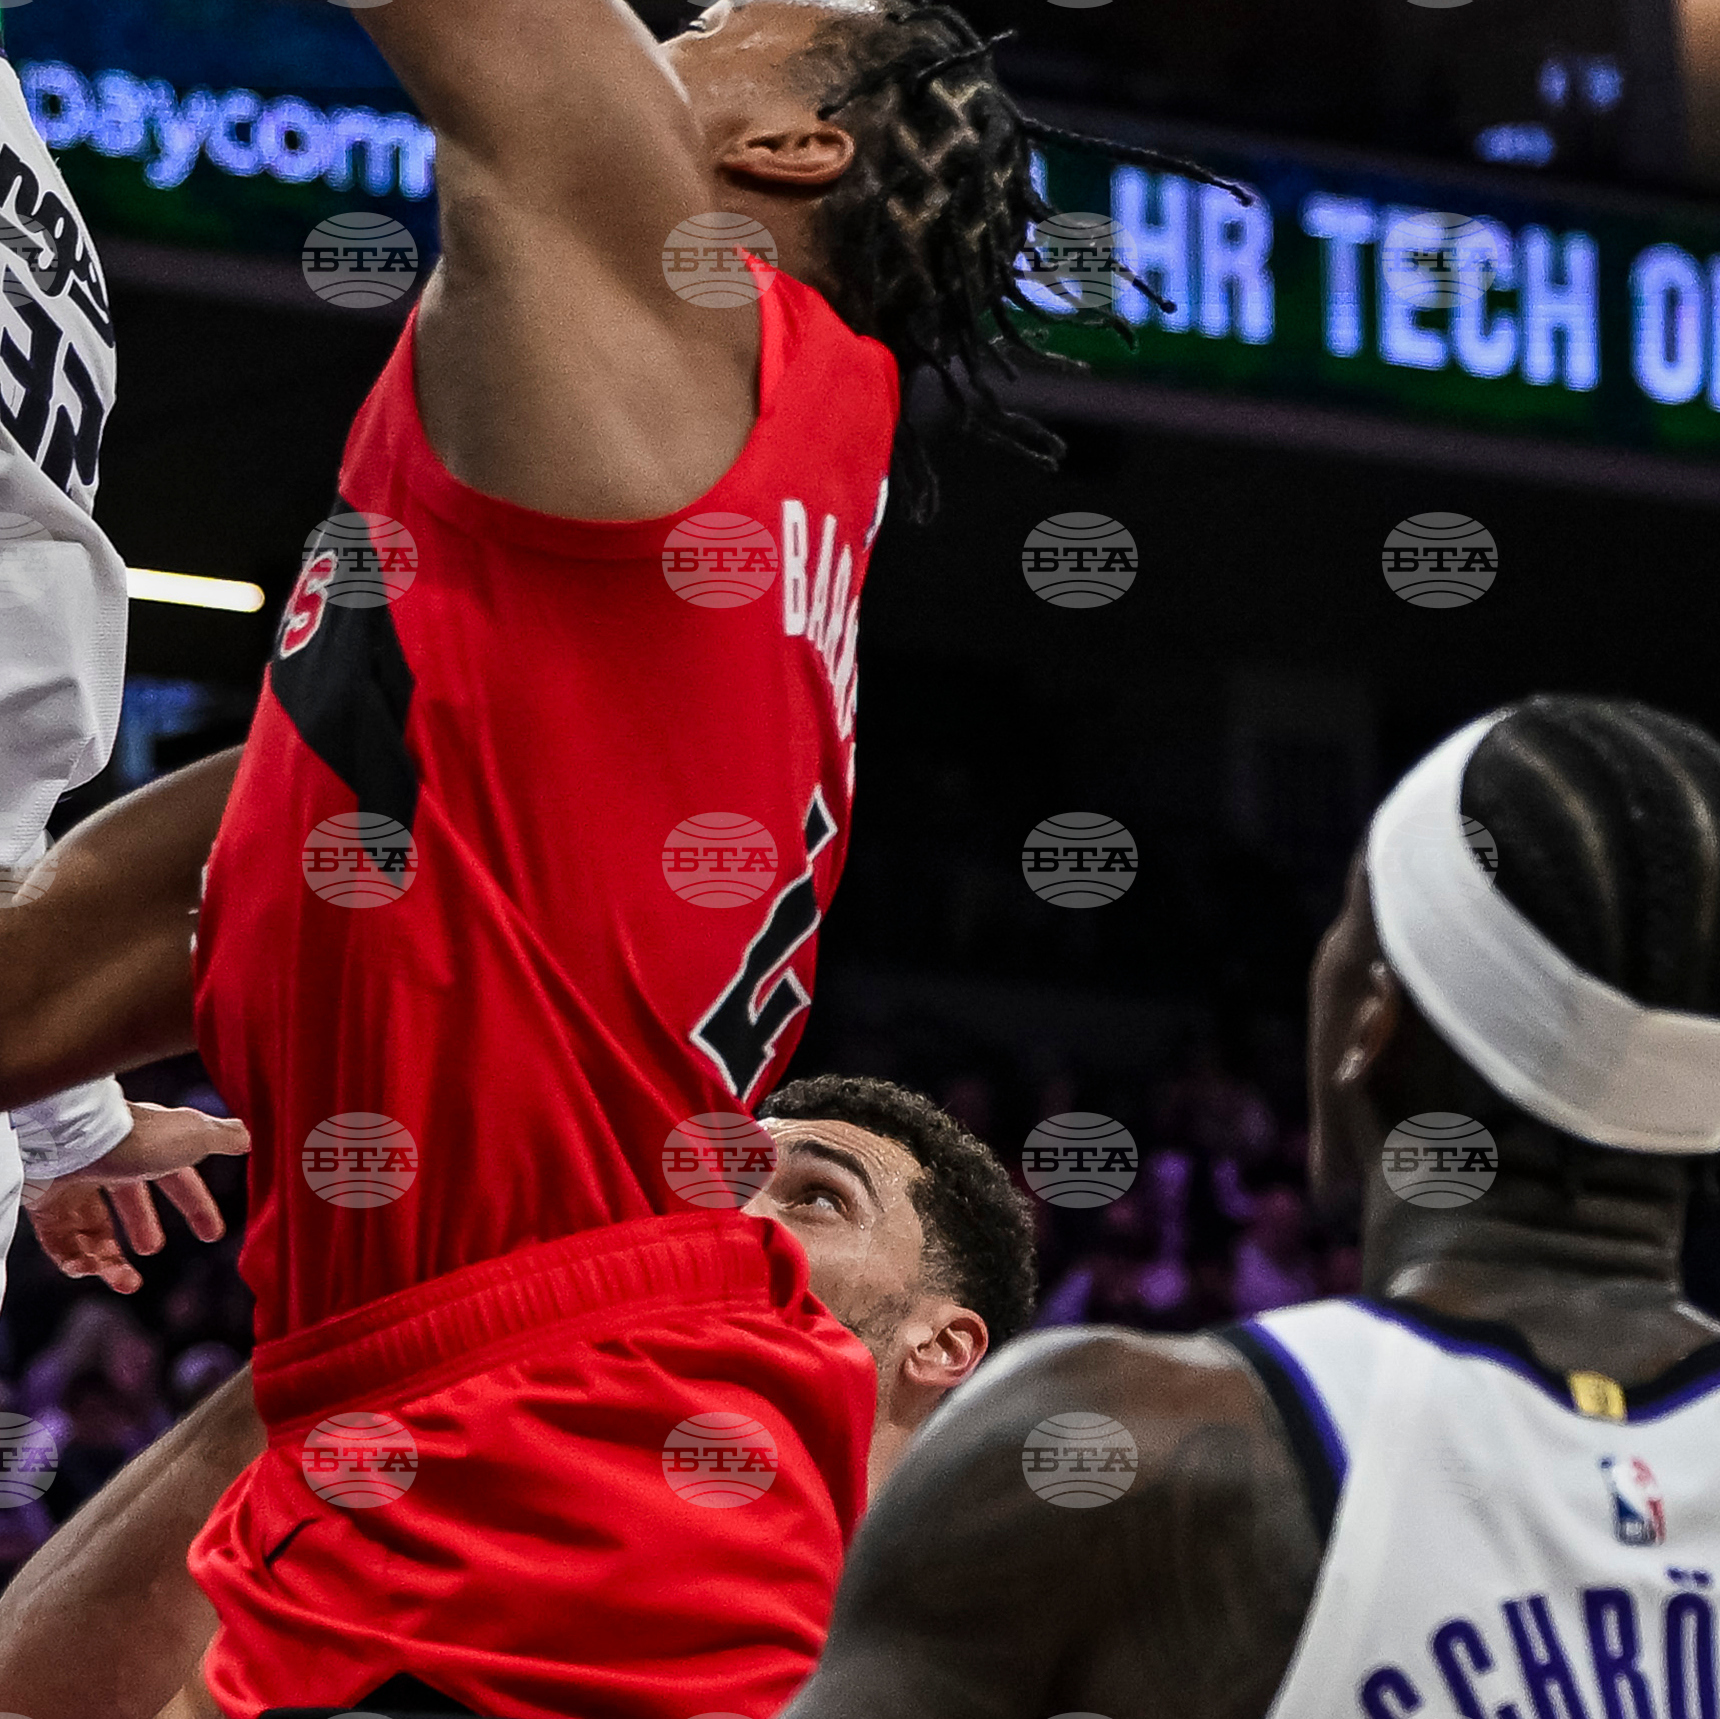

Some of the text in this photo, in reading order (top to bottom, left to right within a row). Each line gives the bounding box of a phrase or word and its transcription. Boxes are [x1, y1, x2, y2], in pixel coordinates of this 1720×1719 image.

[1110, 165, 1275, 345] HR
[1300, 189, 1601, 393] TECH
[1629, 242, 1720, 412] O
